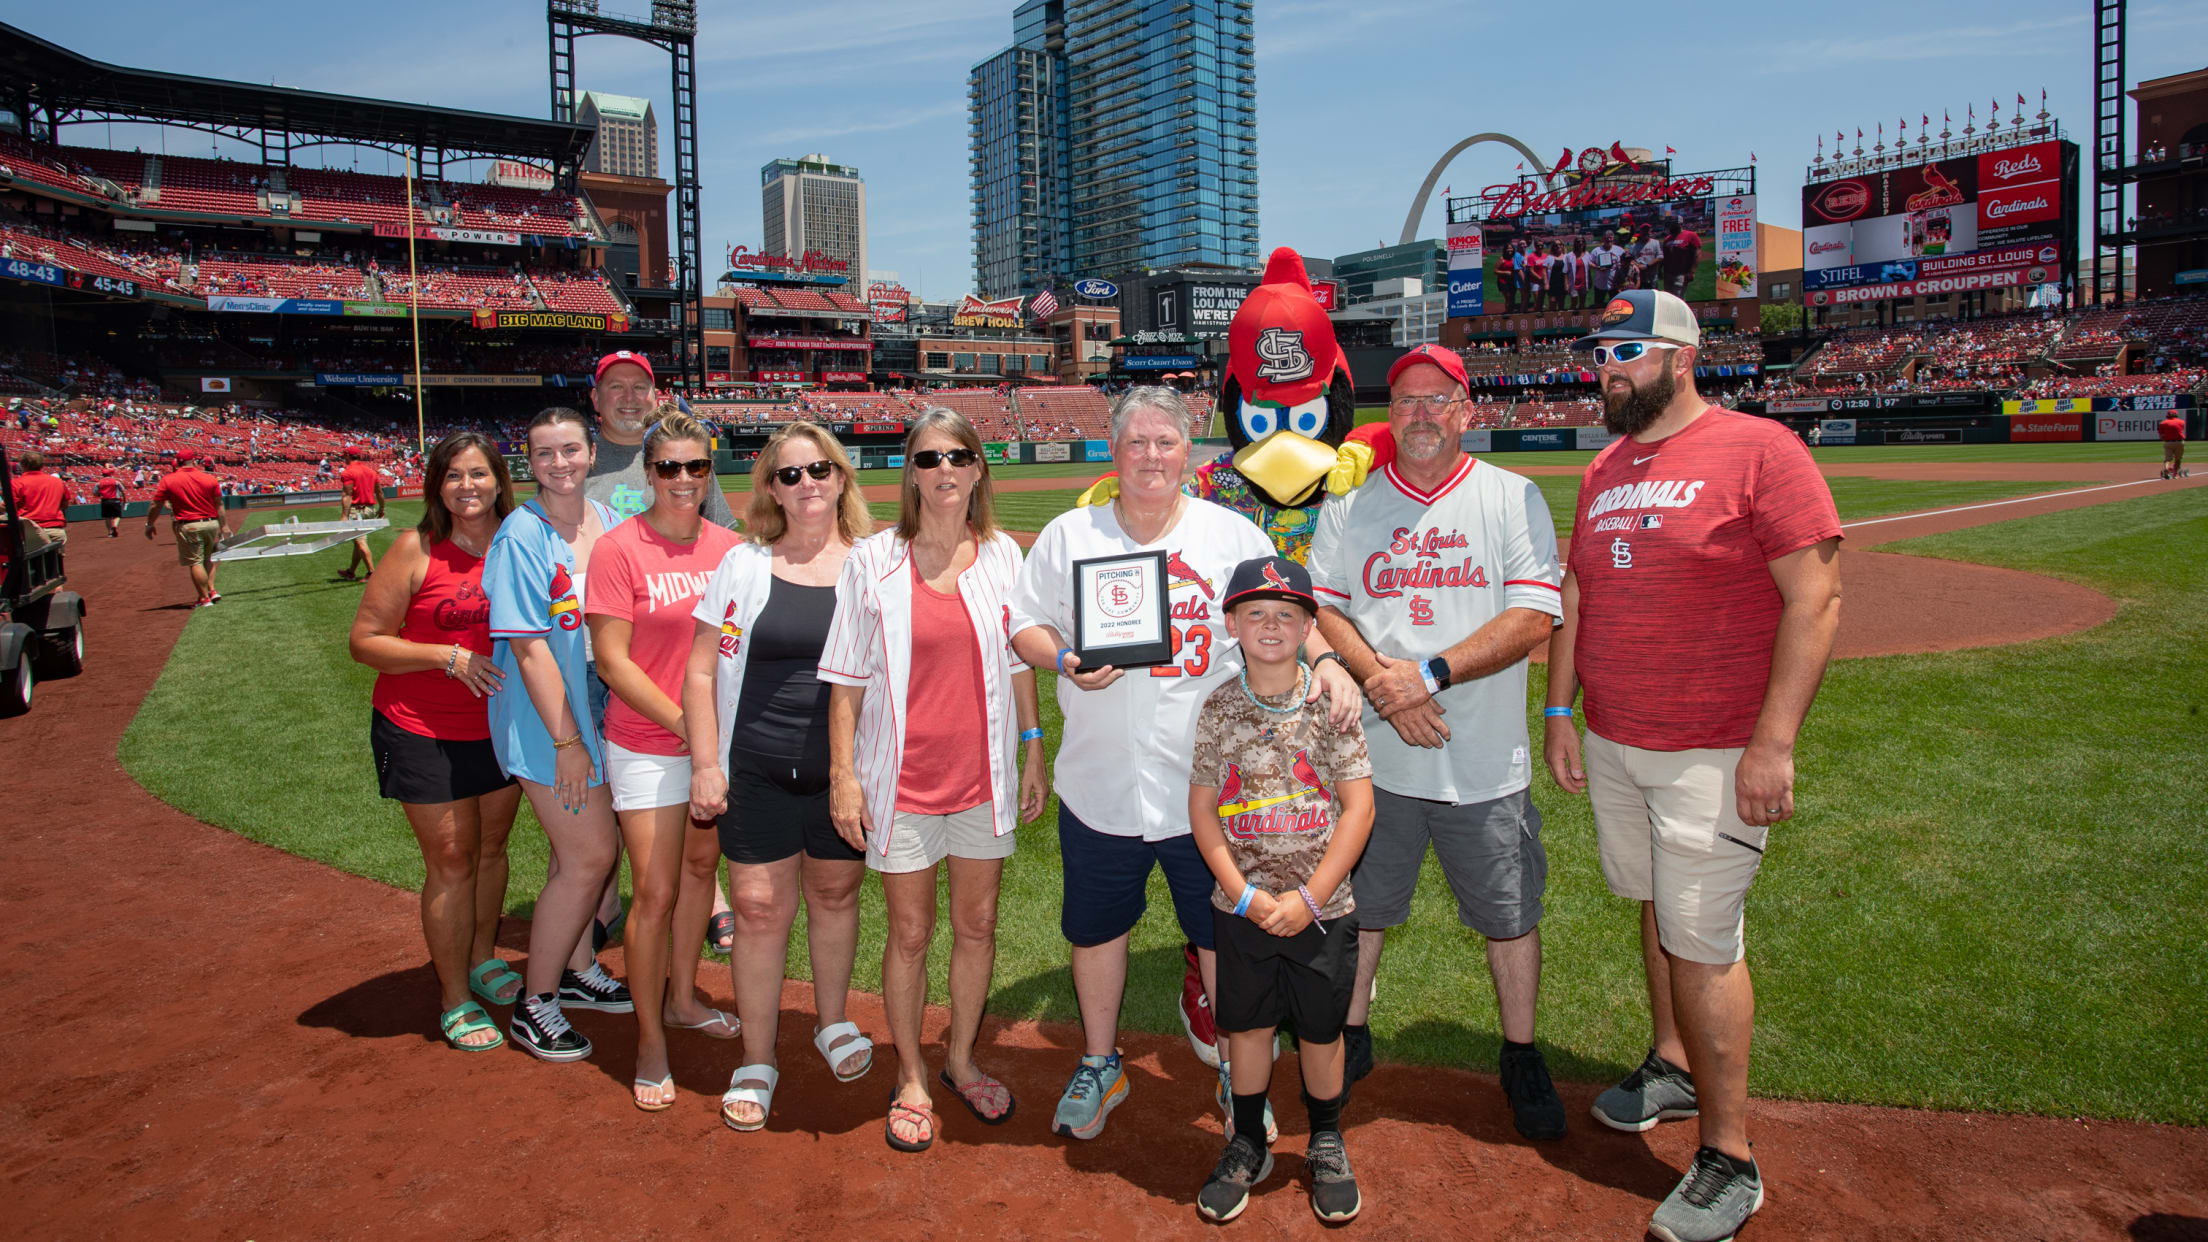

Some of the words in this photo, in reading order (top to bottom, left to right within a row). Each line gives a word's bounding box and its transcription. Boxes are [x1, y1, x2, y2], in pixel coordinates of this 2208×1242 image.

[1828, 154, 1901, 176] WORLD
[1902, 129, 2032, 160] CHAMPIONS
[1993, 153, 2042, 180] Reds
[1481, 175, 1714, 219] Budweiser
[1828, 190, 1867, 208] REDS
[1882, 172, 1890, 215] MATCHUP
[1906, 194, 1966, 213] Cardinals
[1986, 196, 2048, 218] Cardinals
[421, 227, 428, 237] A
[1722, 218, 1752, 233] FREE
[451, 231, 504, 243] POWER
[1448, 234, 1481, 246] KMOX
[1722, 239, 1753, 250] PICKUP
[1809, 240, 1847, 255] Cardinals
[731, 245, 795, 270] Cardinals
[795, 250, 848, 272] Nation
[1922, 256, 1976, 272] BUILDING
[1978, 254, 1995, 265] ST.
[1998, 250, 2034, 263] LOUIS
[7, 261, 56, 281] 48-43
[783, 274, 816, 283] ROOFTOP
[1819, 266, 1864, 284] STIFEL
[93, 276, 134, 296] 45-45
[867, 282, 911, 305] Bally
[1084, 280, 1110, 296] Ford
[1193, 286, 1225, 298] FROM
[1226, 287, 1248, 299] THE
[1450, 281, 1482, 295] Cutter
[1836, 285, 1898, 303] BROWN
[1901, 286, 1912, 296] &
[1915, 272, 2018, 294] CROUPPEN
[956, 300, 1017, 315] Budweise
[1193, 298, 1215, 309] LOU
[1217, 299, 1241, 310] AND
[499, 314, 528, 328] BIG
[529, 315, 566, 329] MAC
[566, 315, 605, 330] LAND
[953, 315, 986, 327] BREW
[1193, 309, 1229, 320] WE'RE
[811, 341, 823, 349] THAT
[1126, 359, 1146, 367] SCOTT
[1147, 358, 1171, 366] CREDIT
[1172, 358, 1193, 366] UNION
[323, 374, 357, 384] Webster
[357, 375, 399, 386] University
[1846, 399, 1870, 408] 12:50
[1884, 398, 1900, 407] 97°
[2133, 394, 2177, 402] SPORTS
[2133, 401, 2177, 410] WATER
[1521, 434, 1558, 442] CENTENE
[1588, 480, 1705, 520] CARDINALS
[1594, 516, 1634, 533] BASEBALL
[1390, 527, 1422, 555] St.
[1416, 527, 1469, 559] Louis
[1099, 570, 1134, 580] PITCHING
[1363, 556, 1490, 599] Cardinals
[645, 570, 716, 614] MIDW
[433, 598, 490, 631] Cardi
[1100, 621, 1115, 629] 2022
[1116, 619, 1142, 627] HONOREE
[1228, 803, 1330, 841] Cardinals
